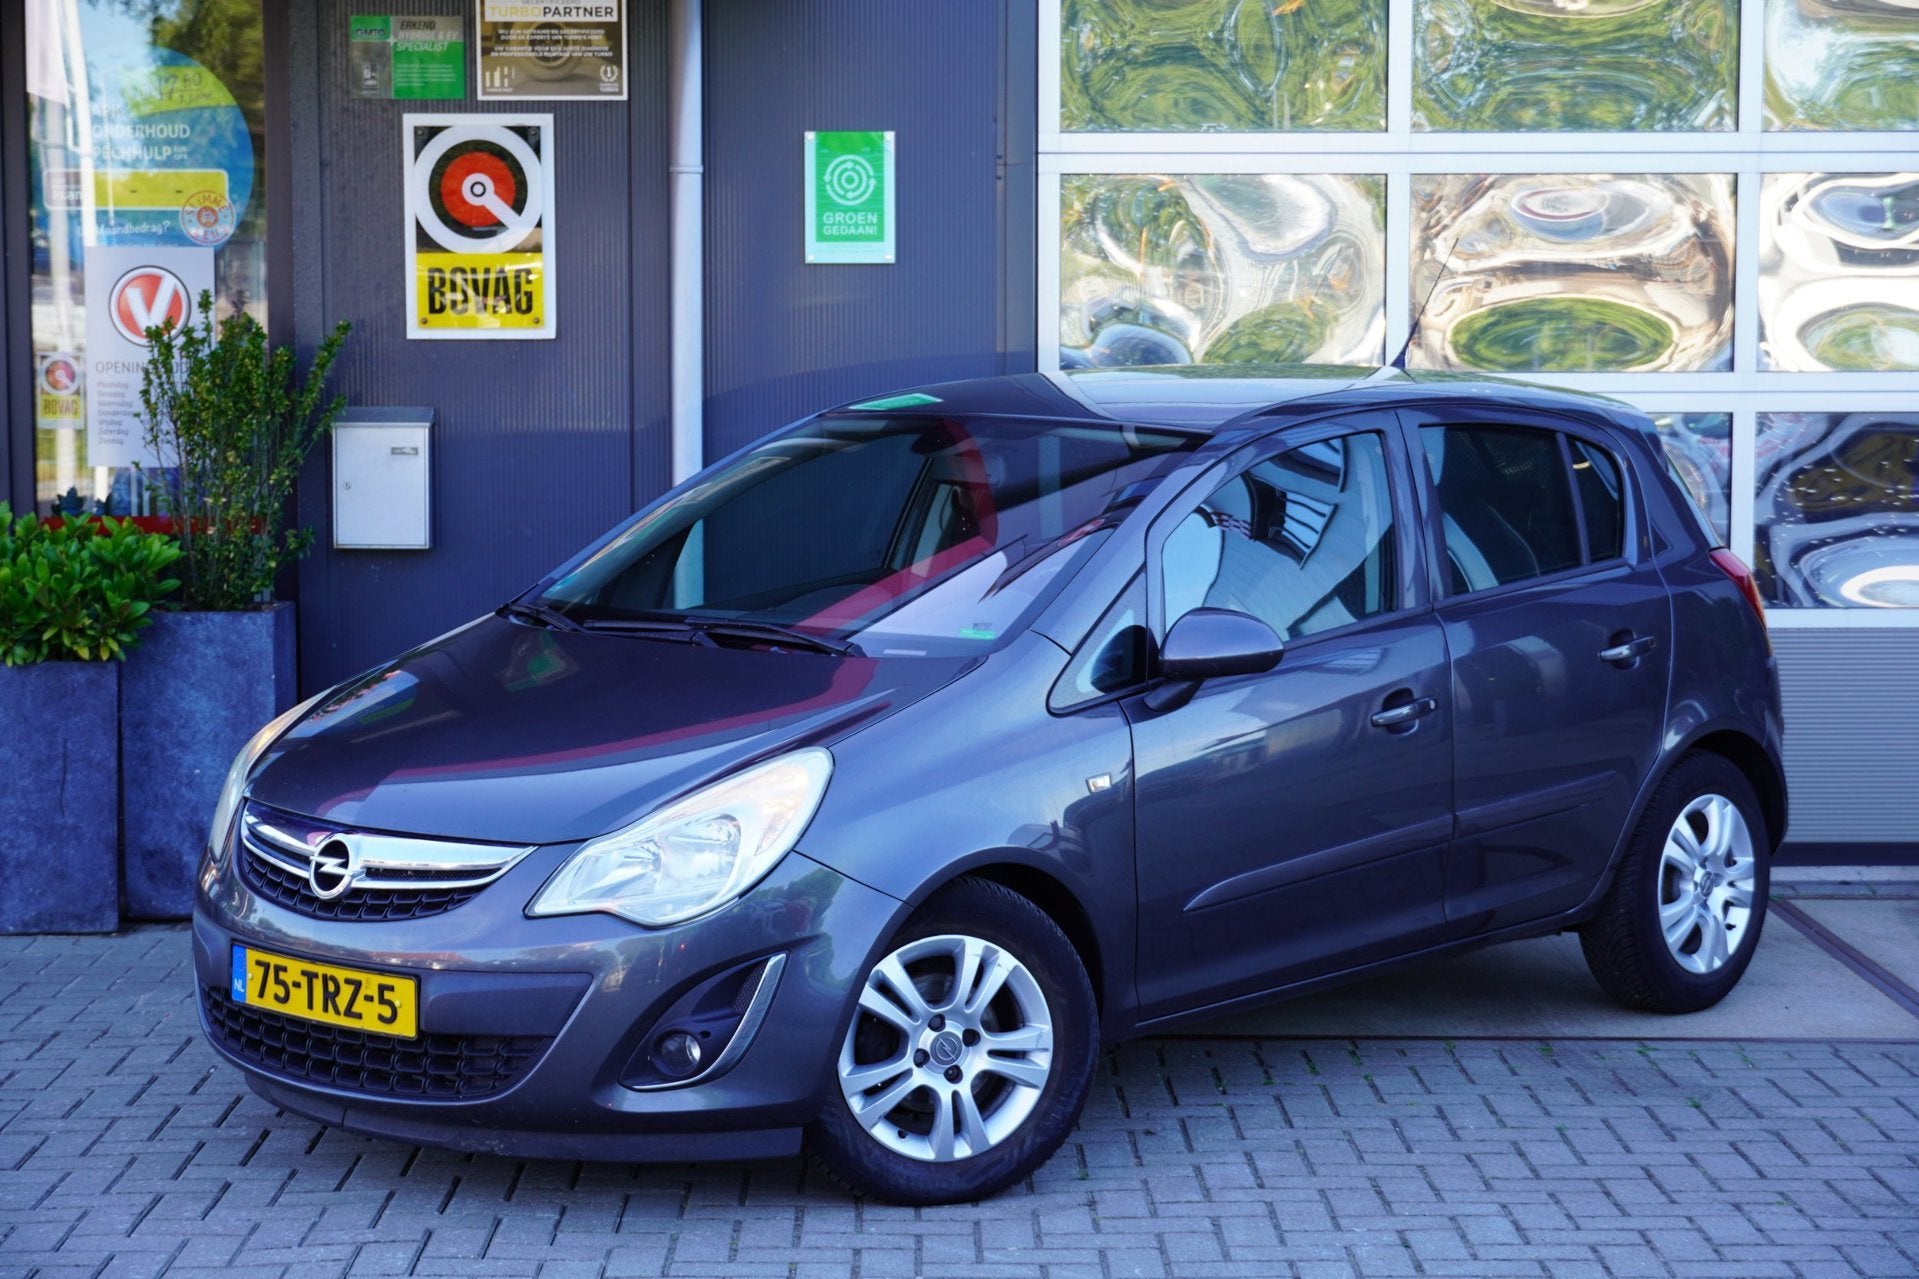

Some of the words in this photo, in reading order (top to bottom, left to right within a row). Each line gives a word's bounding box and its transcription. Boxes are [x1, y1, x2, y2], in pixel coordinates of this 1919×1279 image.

[489, 6, 614, 17] TURBOPARTNER
[400, 20, 436, 30] ERKEND
[396, 41, 449, 52] SPECIALIST
[93, 124, 191, 139] ONDERHOUD
[92, 145, 172, 160] PECHHULP
[823, 212, 877, 224] GROEN
[823, 225, 877, 236] GEDAAN!
[427, 266, 533, 315] BOVAG
[43, 398, 78, 416] BOVAG
[234, 979, 245, 992] NL
[254, 959, 398, 1024] 75-TRZ-5
